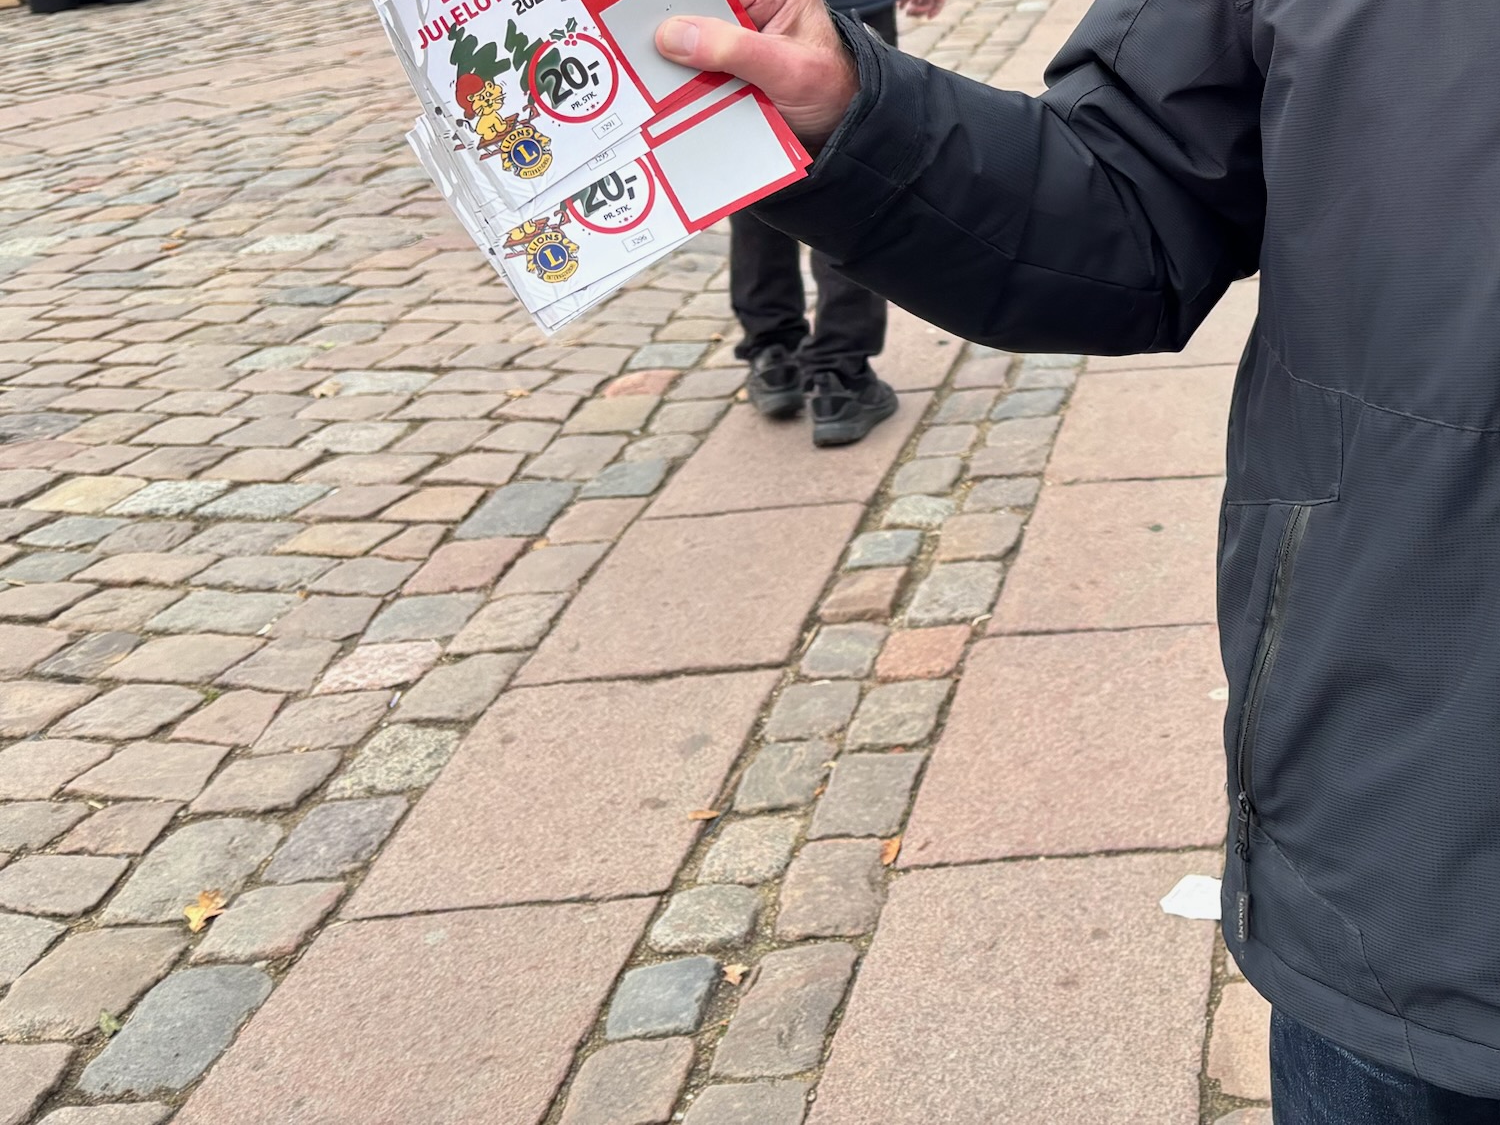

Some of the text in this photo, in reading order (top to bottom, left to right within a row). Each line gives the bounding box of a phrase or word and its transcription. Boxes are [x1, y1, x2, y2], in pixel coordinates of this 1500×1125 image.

[502, 128, 531, 149] LIONS
[517, 144, 539, 163] L
[529, 234, 560, 252] LIONS
[542, 248, 564, 268] L
